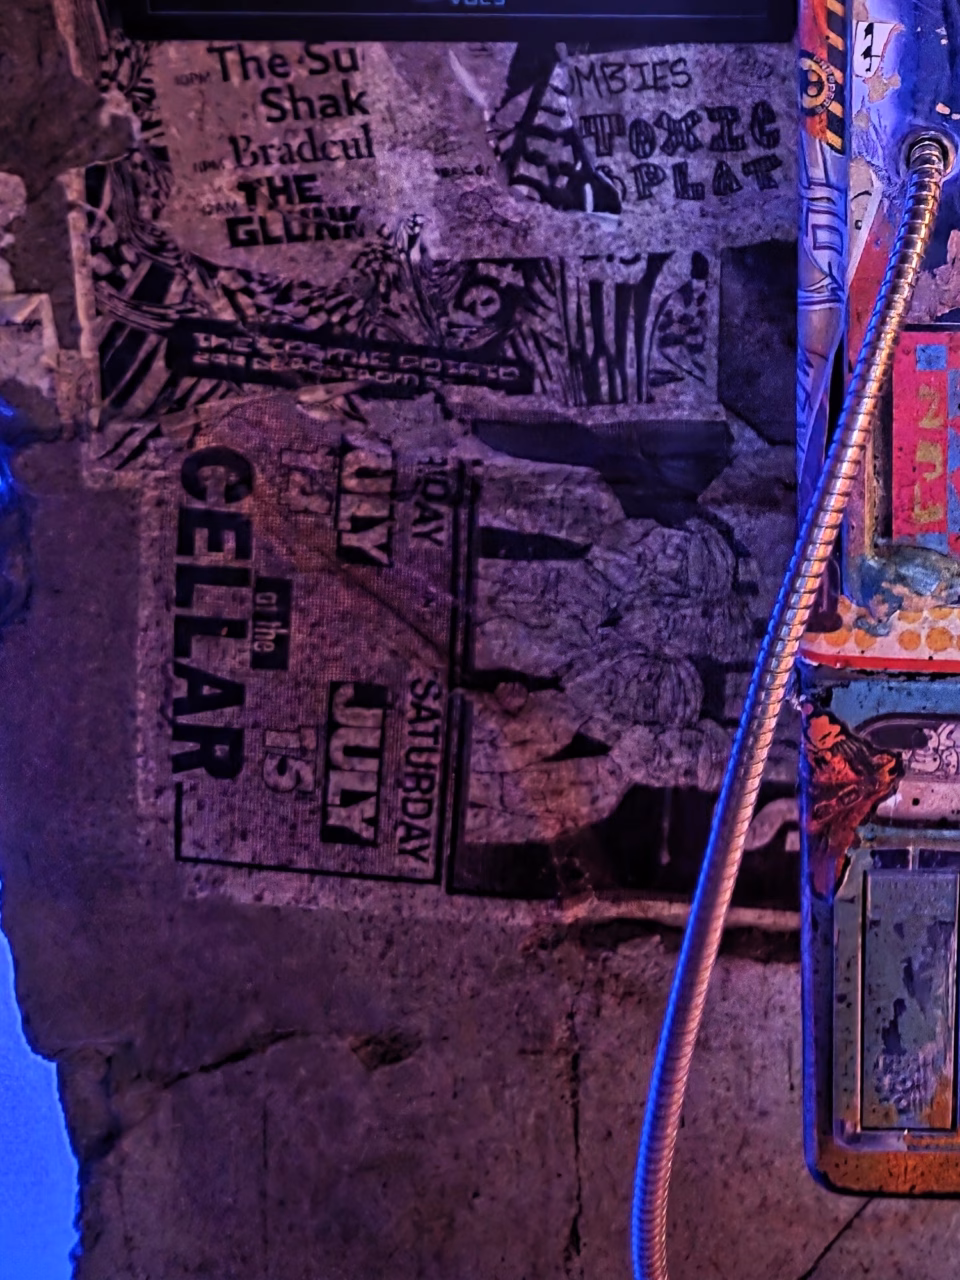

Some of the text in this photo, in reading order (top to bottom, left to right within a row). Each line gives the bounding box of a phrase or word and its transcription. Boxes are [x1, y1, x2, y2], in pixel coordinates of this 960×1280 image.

[207, 43, 291, 82] The
[260, 79, 370, 123] Shak
[579, 99, 781, 160] TOXIC
[237, 173, 323, 212] THE
[172, 445, 254, 781] CELLAR
[262, 726, 319, 794] 15
[320, 680, 388, 847] JULY
[397, 677, 446, 865] SATURDAY
